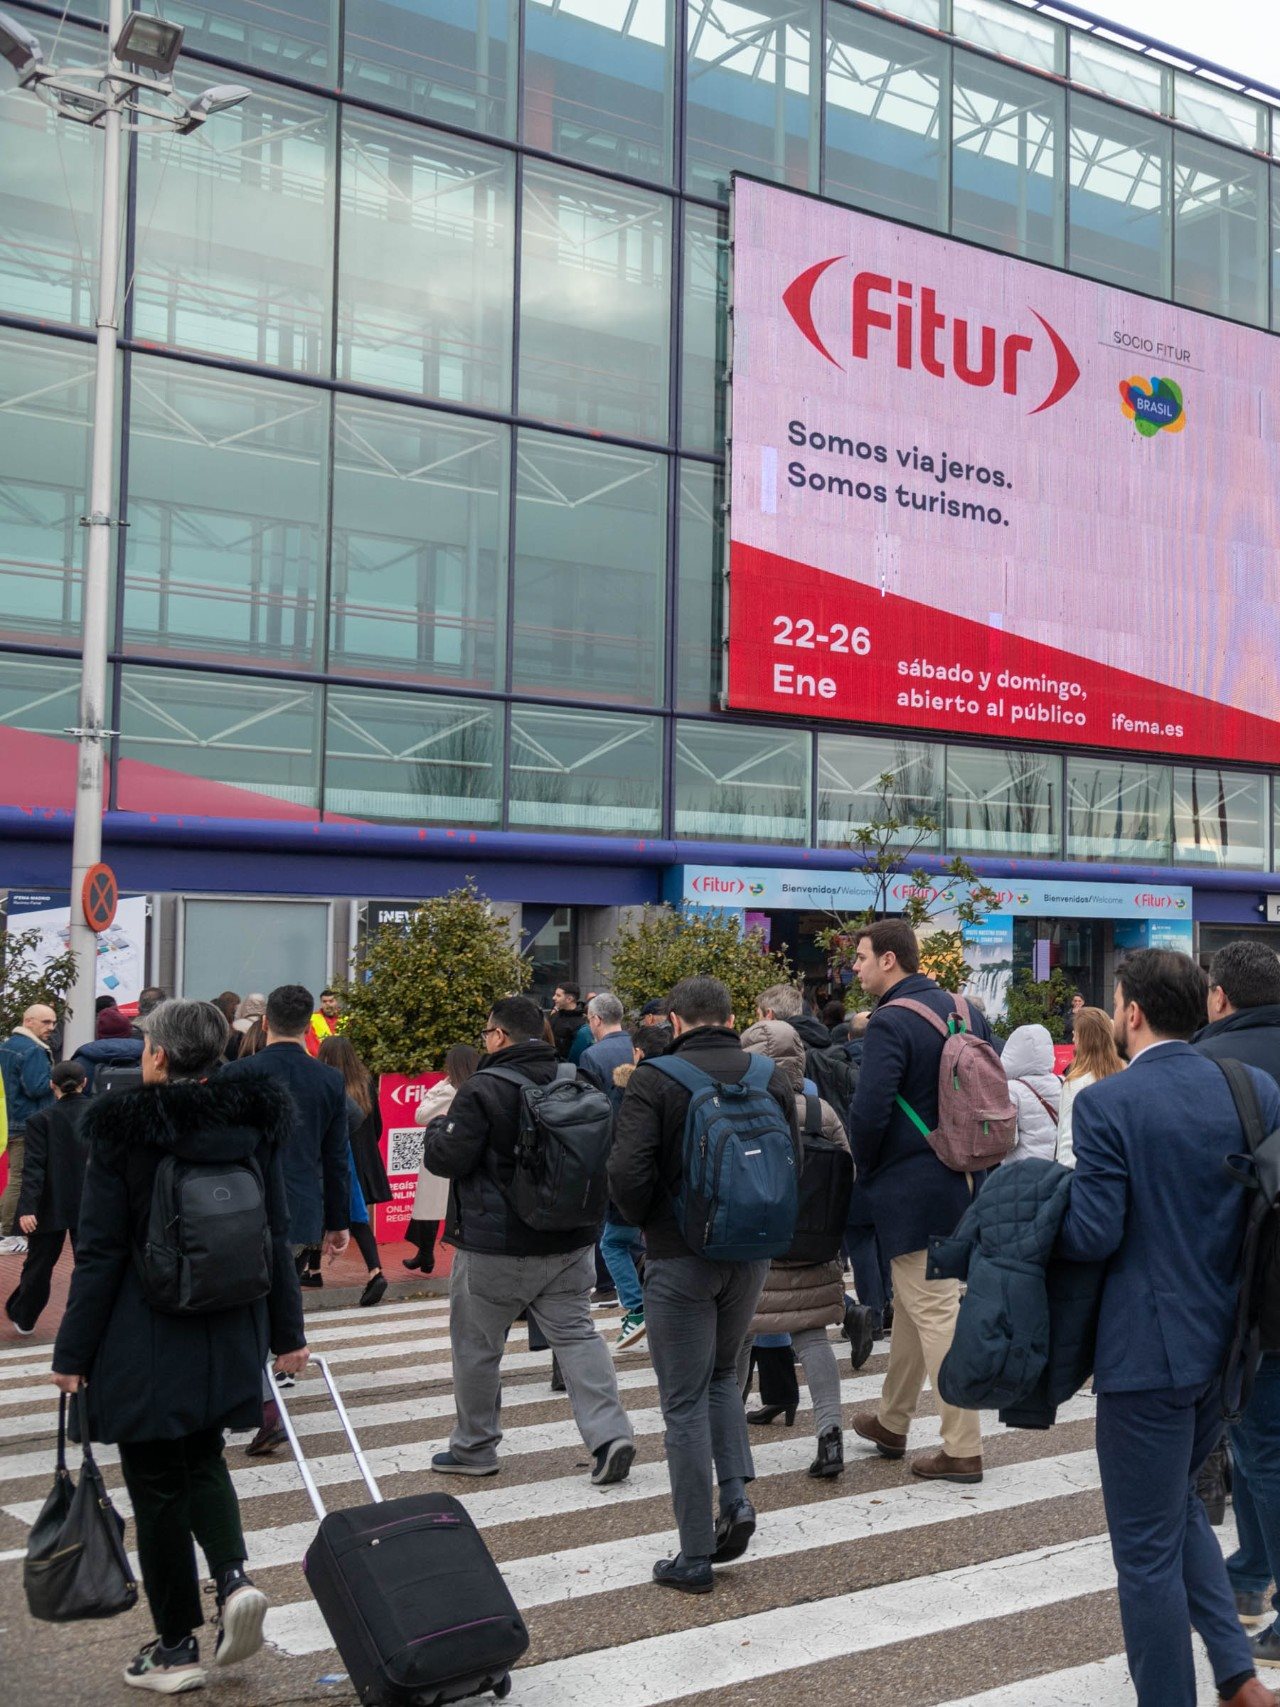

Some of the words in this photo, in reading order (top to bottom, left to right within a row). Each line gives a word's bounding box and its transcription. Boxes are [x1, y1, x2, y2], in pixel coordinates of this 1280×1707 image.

[852, 271, 1033, 396] Fitur
[1113, 330, 1154, 353] SOCIO
[1156, 342, 1191, 363] FITUR
[1136, 397, 1173, 418] BRASIL
[788, 420, 888, 464] Somos
[896, 447, 1013, 491] viajeros.
[788, 461, 888, 504] Somos
[896, 483, 1010, 527] turismo.
[772, 615, 871, 656] 22-26
[772, 664, 837, 699] Ene
[897, 657, 973, 684] sábado
[979, 669, 991, 691] y
[996, 668, 1087, 701] domingo,
[897, 688, 979, 715] abierto
[986, 694, 1004, 718] al
[1011, 697, 1086, 727] público
[1112, 712, 1184, 738] ifema.es
[703, 877, 735, 893] Fitur
[1142, 894, 1165, 907] Fitur
[405, 1085, 427, 1103] Fit
[386, 1204, 413, 1214] ONLIN
[386, 1214, 411, 1222] REGIS
